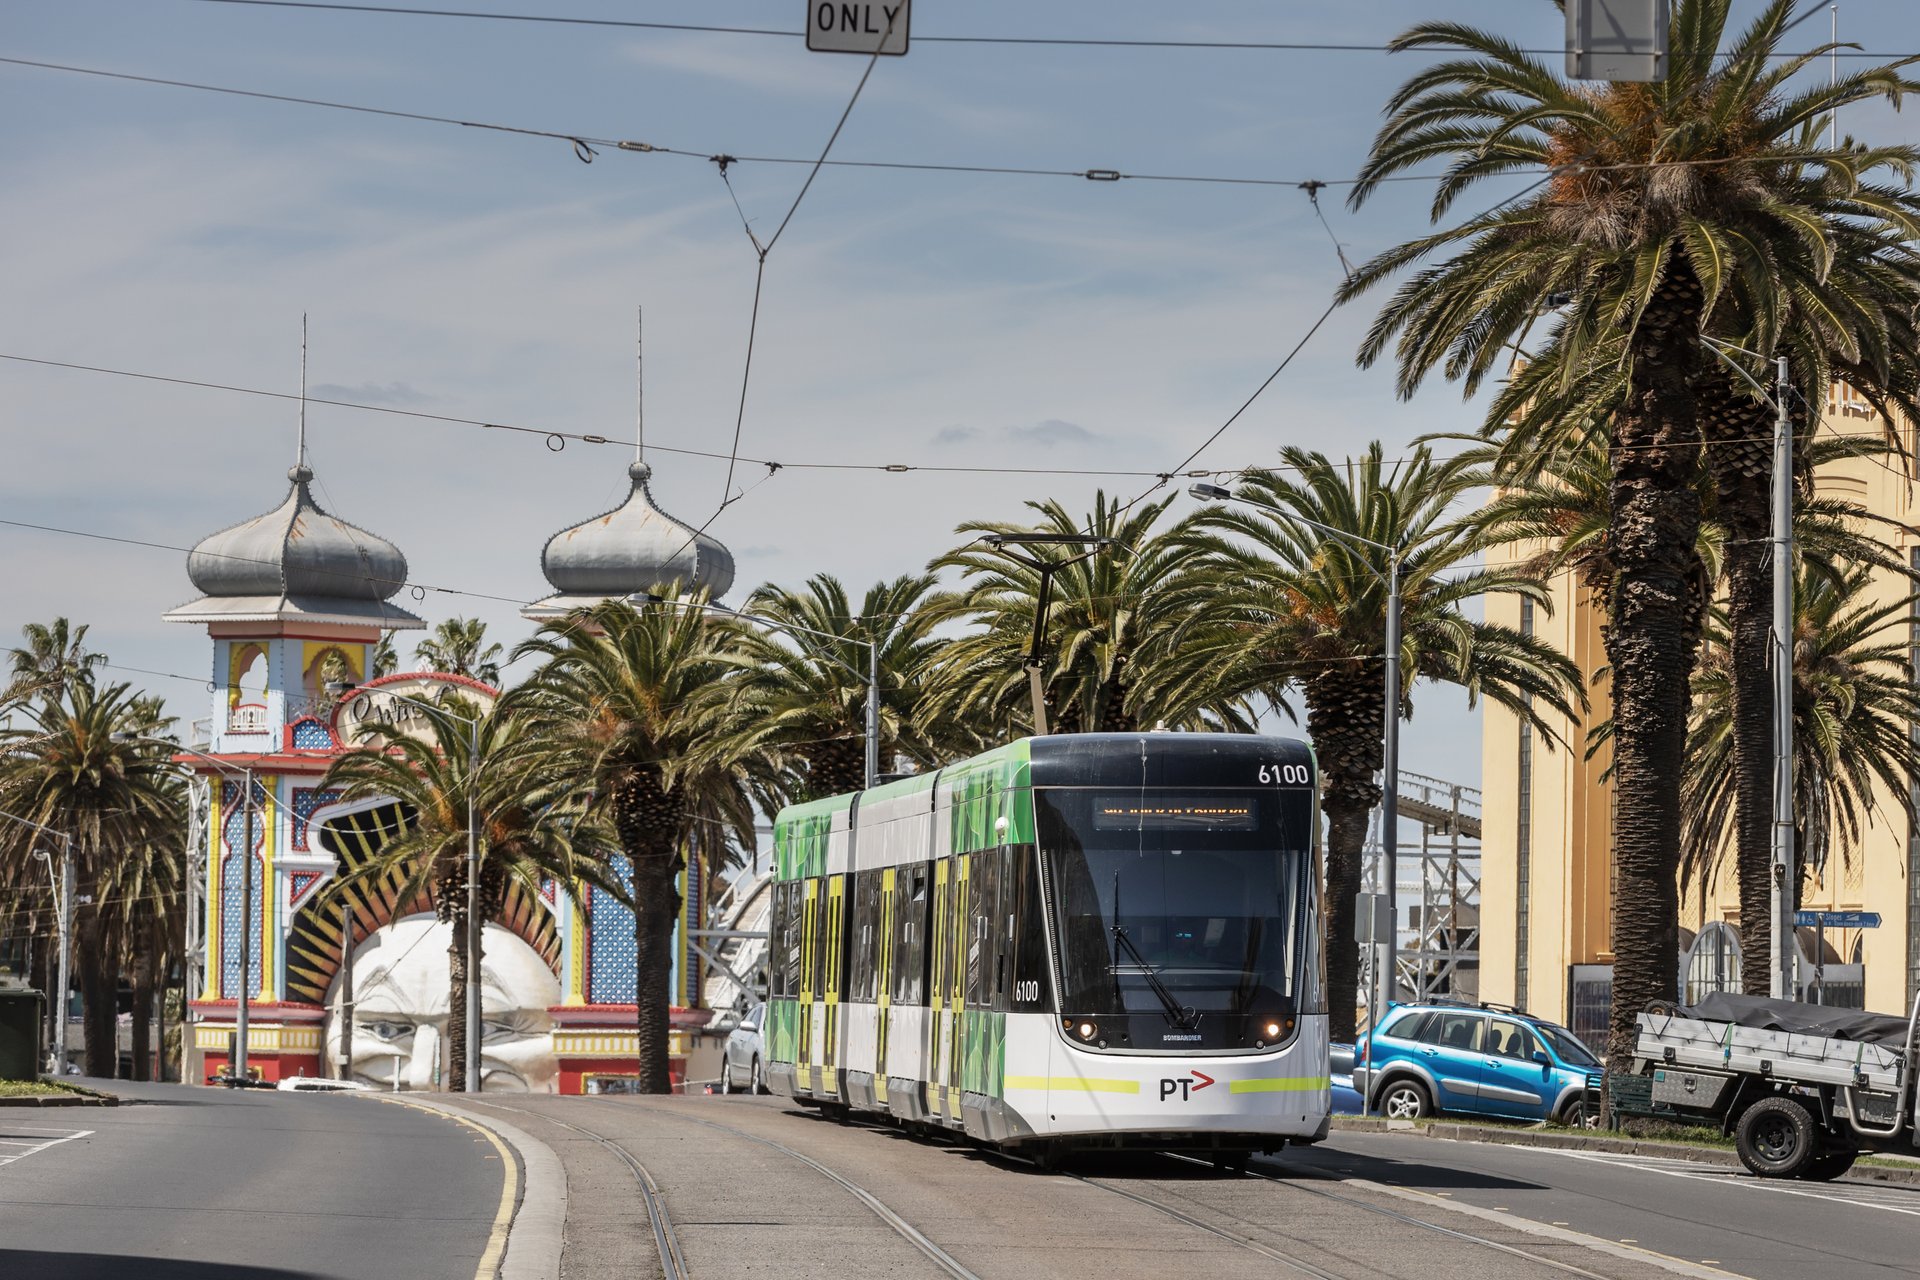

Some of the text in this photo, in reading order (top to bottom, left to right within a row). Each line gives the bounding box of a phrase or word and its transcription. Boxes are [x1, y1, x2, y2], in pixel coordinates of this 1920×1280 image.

[817, 2, 899, 34] ONLY
[1258, 764, 1309, 784] 6100
[1016, 980, 1038, 1001] 6100
